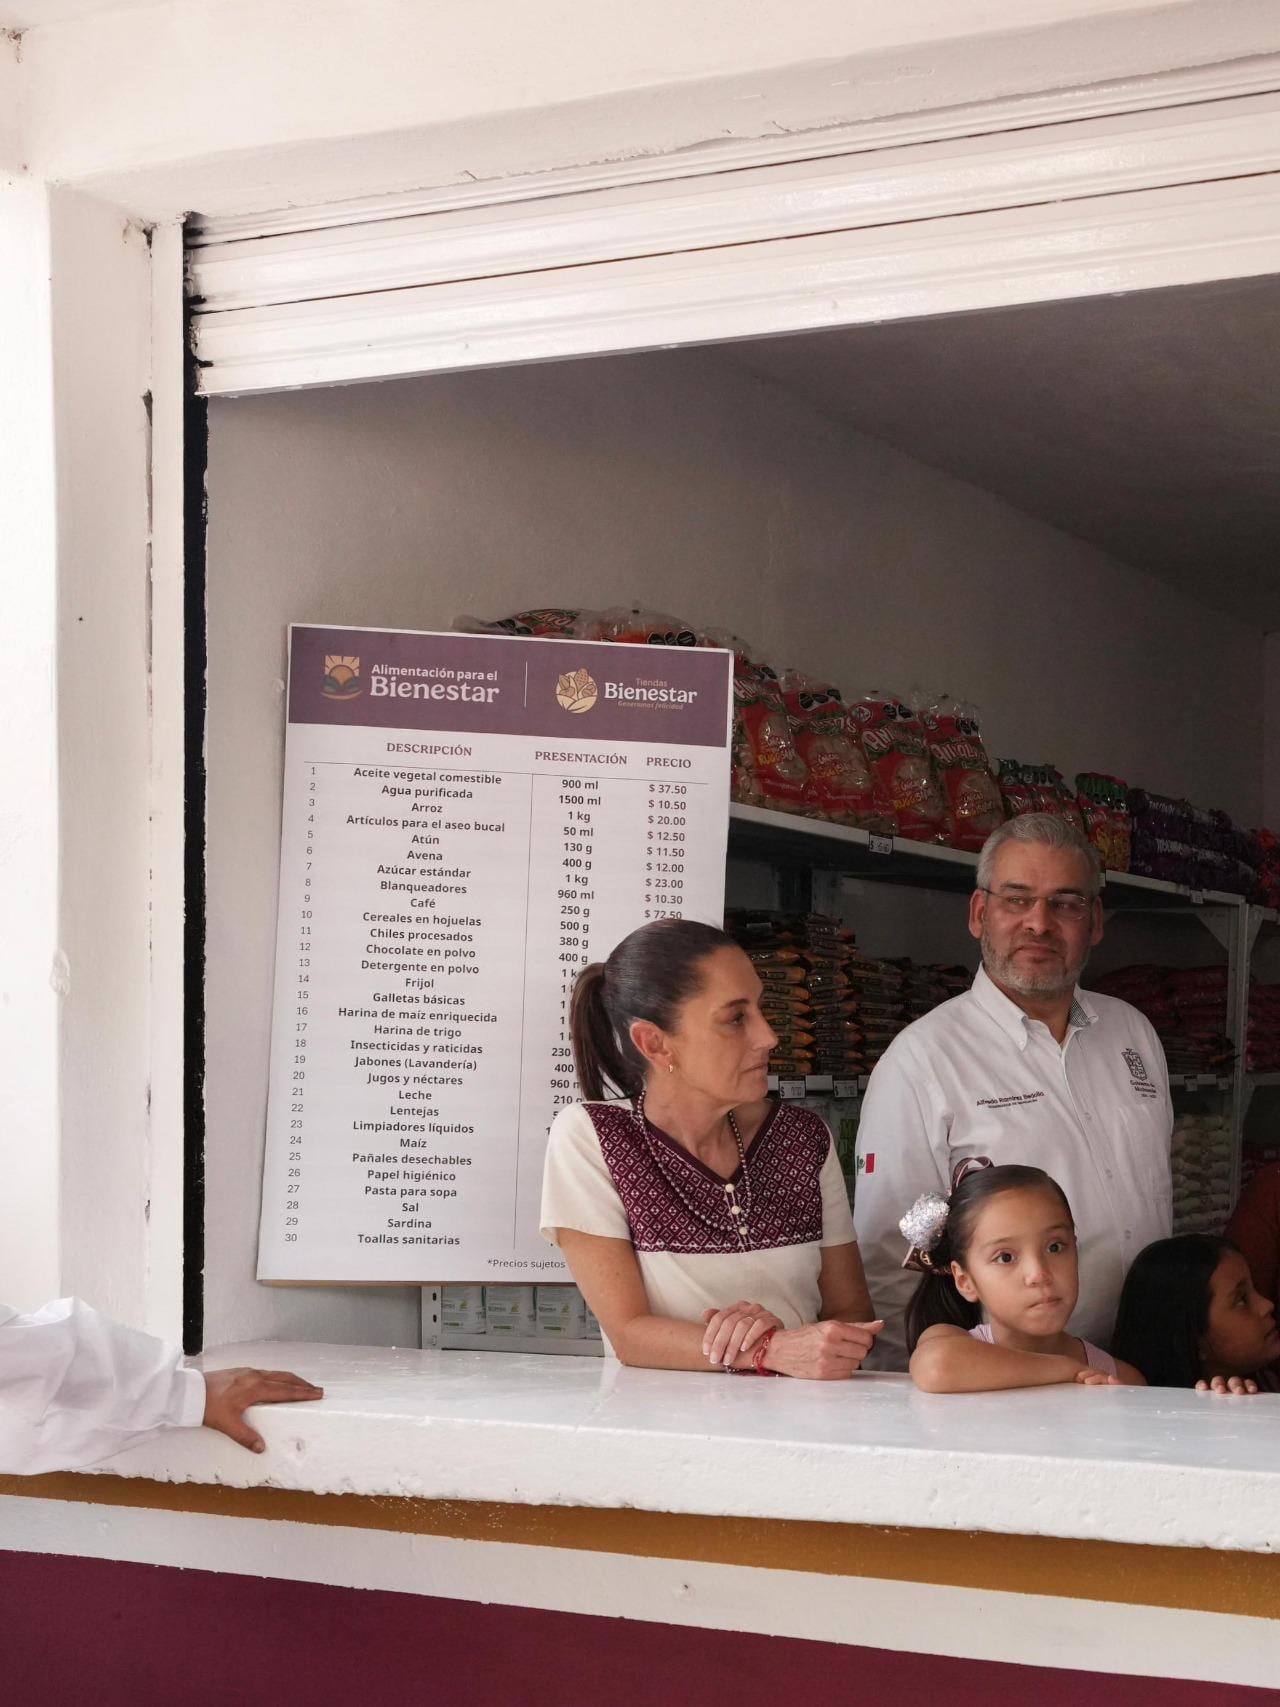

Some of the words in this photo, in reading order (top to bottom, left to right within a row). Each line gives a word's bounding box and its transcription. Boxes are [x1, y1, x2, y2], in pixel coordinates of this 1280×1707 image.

[371, 664, 455, 678] Alimentación
[457, 670, 485, 681] para
[487, 671, 498, 681] el
[370, 676, 500, 703] Bienestar
[636, 678, 668, 688] Tiendas
[604, 682, 698, 703] Bienestar
[386, 742, 472, 756] DESCRIPCIÓN
[535, 751, 627, 765] PRESENTACIÓN
[646, 756, 692, 768] PRECIO
[353, 767, 390, 778] Aceite
[393, 767, 436, 782] vegetal
[439, 774, 502, 784] comestible
[562, 779, 582, 789] 900
[584, 780, 599, 790] ml
[649, 784, 655, 792] $
[658, 784, 687, 795] 37.50
[381, 785, 412, 797] Agua
[414, 787, 473, 799] purificada
[558, 794, 584, 805] 1500
[587, 796, 601, 806] ml
[648, 799, 655, 808] $
[658, 800, 686, 811] 10.50
[411, 802, 443, 813] Arroz
[346, 815, 399, 827] Artículos
[401, 820, 428, 830] para
[431, 819, 442, 829] el
[444, 822, 471, 831] aseo
[474, 821, 505, 832] bucal
[568, 811, 573, 820] 1
[577, 810, 591, 824] kg
[648, 815, 654, 824] $
[657, 815, 686, 826] 20.00
[563, 826, 577, 836] 50
[579, 827, 594, 837] ml
[647, 831, 654, 840] $
[657, 831, 685, 842] 12.50
[411, 834, 440, 845] Atún
[564, 842, 583, 852] 130
[585, 845, 592, 855] g
[646, 846, 653, 856] $
[656, 847, 685, 858] 11.50
[406, 850, 443, 861] Avena
[376, 864, 417, 876] Azúcar
[420, 867, 472, 878] estándar
[562, 858, 582, 868] 400
[584, 861, 592, 871] g
[646, 862, 652, 871] $
[656, 863, 684, 873] 12.00
[565, 874, 570, 883] 1
[574, 874, 588, 886] kg
[645, 878, 652, 887] $
[655, 878, 684, 889] 23.00
[380, 880, 467, 894] Blanqueadores
[557, 889, 577, 899] 960
[580, 890, 594, 900] ml
[645, 894, 651, 903] $
[654, 894, 683, 905] 10.30
[410, 898, 436, 908] Café
[560, 905, 580, 915] 250
[582, 908, 590, 918] g
[645, 910, 650, 918] $
[654, 910, 683, 919] 72.50
[362, 912, 412, 924] Cereales
[415, 916, 430, 924] en
[432, 914, 482, 928] hojuelas
[560, 920, 580, 931] 500
[582, 924, 590, 934] g
[370, 928, 405, 939] Chiles
[408, 932, 473, 942] procesados
[559, 936, 579, 947] 380
[581, 939, 589, 950] g
[366, 944, 424, 956] Chocolate
[426, 948, 441, 956] en
[444, 948, 476, 960] polvo
[558, 952, 578, 962] 400
[581, 955, 588, 966] g
[361, 960, 428, 974] Detergente
[430, 964, 445, 973] en
[448, 964, 480, 976] polvo
[405, 978, 434, 990] Frijol
[373, 992, 420, 1004] Galletas
[423, 994, 465, 1006] básicas
[338, 1007, 378, 1018] Harina
[381, 1008, 396, 1019] de
[398, 1010, 426, 1020] maíz
[429, 1011, 497, 1024] enriquecida
[374, 1024, 413, 1036] Harina
[416, 1026, 430, 1036] de
[433, 1027, 462, 1040] trigo
[350, 1040, 420, 1052] Insecticidas
[422, 1044, 430, 1055] y
[432, 1043, 483, 1054] raticidas
[551, 1047, 571, 1057] 230
[354, 1056, 402, 1068] Jabones
[404, 1058, 477, 1071] (Lavandería)
[554, 1063, 574, 1073] 400
[366, 1072, 400, 1085] Jugos
[402, 1076, 410, 1086] y
[413, 1074, 463, 1086] néctares
[550, 1079, 570, 1089] 960
[398, 1090, 432, 1100] Leche
[553, 1095, 573, 1104] 210
[390, 1106, 439, 1119] Lentejas
[353, 1120, 426, 1133] Limpiadores
[428, 1122, 474, 1135] líquidos
[400, 1138, 427, 1148] Maíz
[352, 1153, 398, 1164] Pañales
[401, 1154, 472, 1166] desechables
[367, 1169, 400, 1182] Papel
[403, 1170, 456, 1183] higiénico
[364, 1185, 397, 1196] Pasta
[400, 1188, 427, 1199] para
[430, 1189, 457, 1200] sopa
[402, 1202, 419, 1212] Sal
[387, 1218, 432, 1228] Sardina
[357, 1234, 399, 1244] Toallas
[402, 1234, 460, 1246] sanitarias
